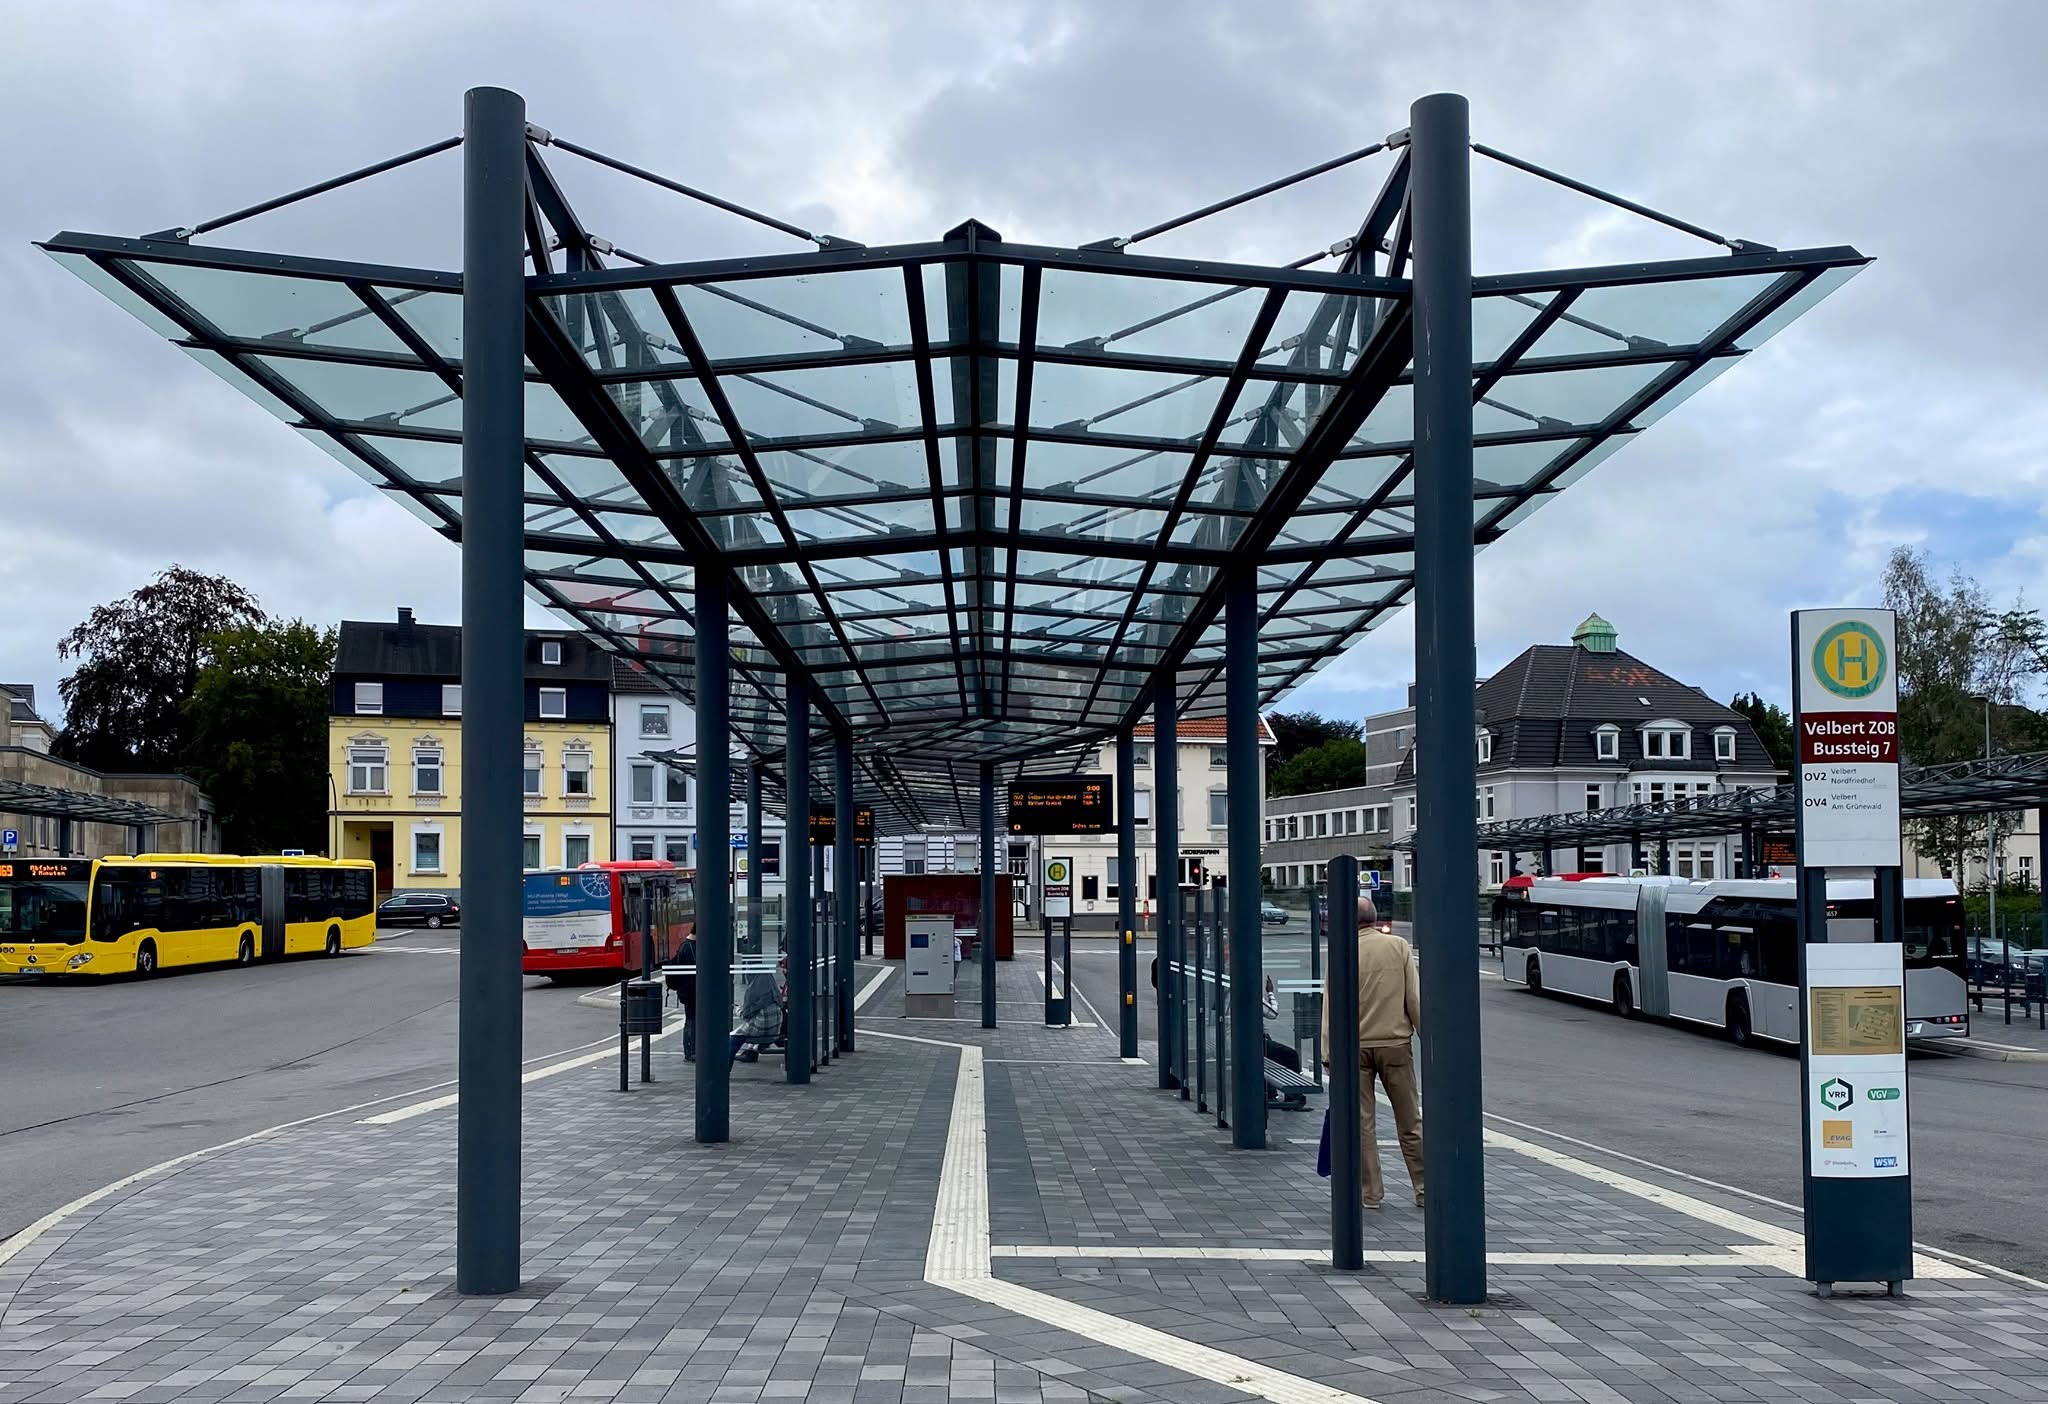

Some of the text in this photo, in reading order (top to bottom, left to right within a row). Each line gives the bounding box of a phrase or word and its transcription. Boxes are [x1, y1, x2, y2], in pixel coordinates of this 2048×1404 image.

[1837, 638, 1868, 681] H
[1804, 720, 1896, 735] Velbert ZOB
[1813, 740, 1891, 759] Bussteig 7
[1804, 772, 1827, 782] OV2
[1830, 777, 1876, 785] Nordfriedhof
[1804, 798, 1828, 807] OV4
[6, 831, 15, 843] P
[1870, 1090, 1888, 1099] VGV
